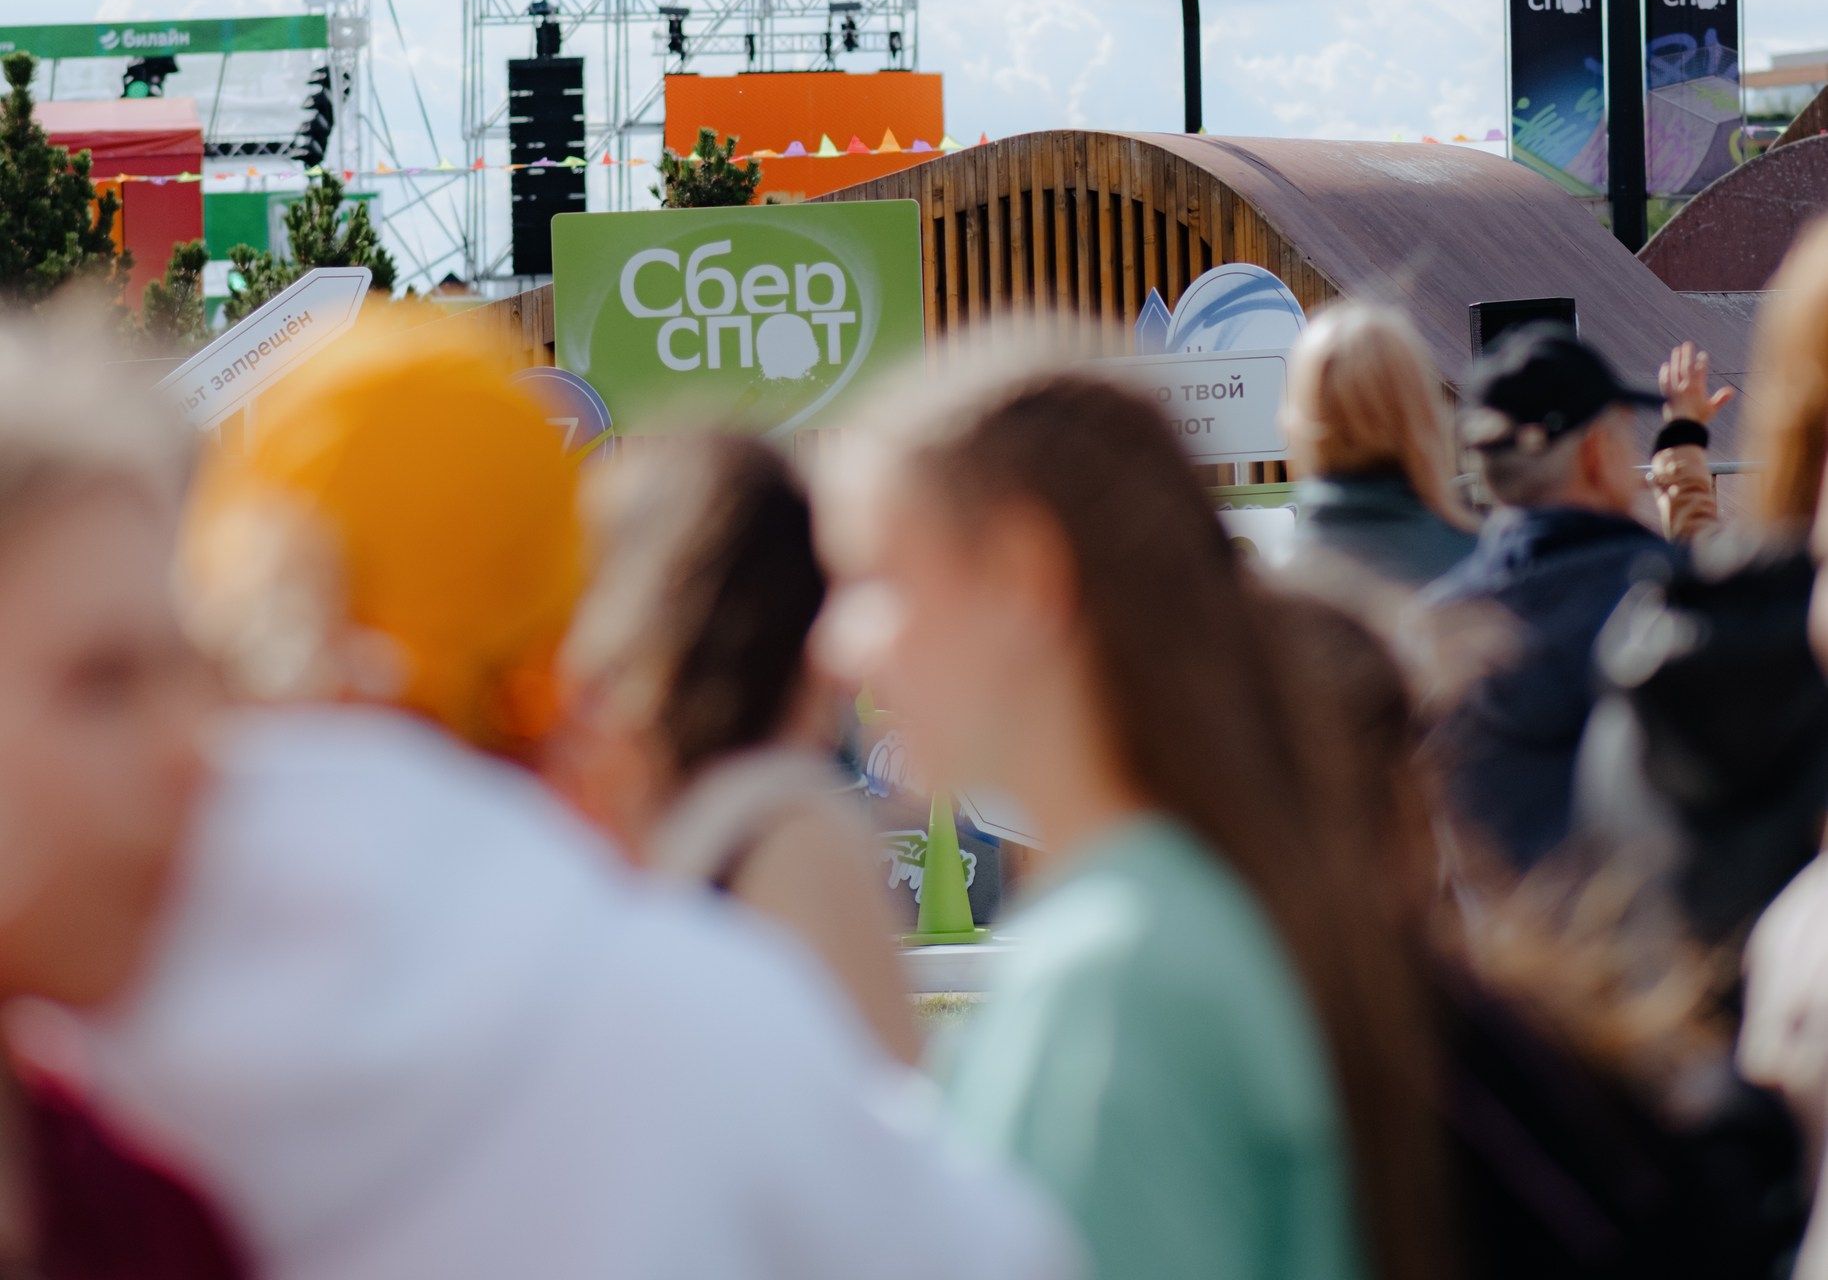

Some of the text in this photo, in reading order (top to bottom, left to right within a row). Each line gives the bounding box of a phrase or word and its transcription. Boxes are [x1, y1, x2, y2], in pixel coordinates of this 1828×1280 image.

[122, 28, 190, 48] билайн
[619, 239, 847, 318] Сбер
[210, 309, 313, 392] запрещён
